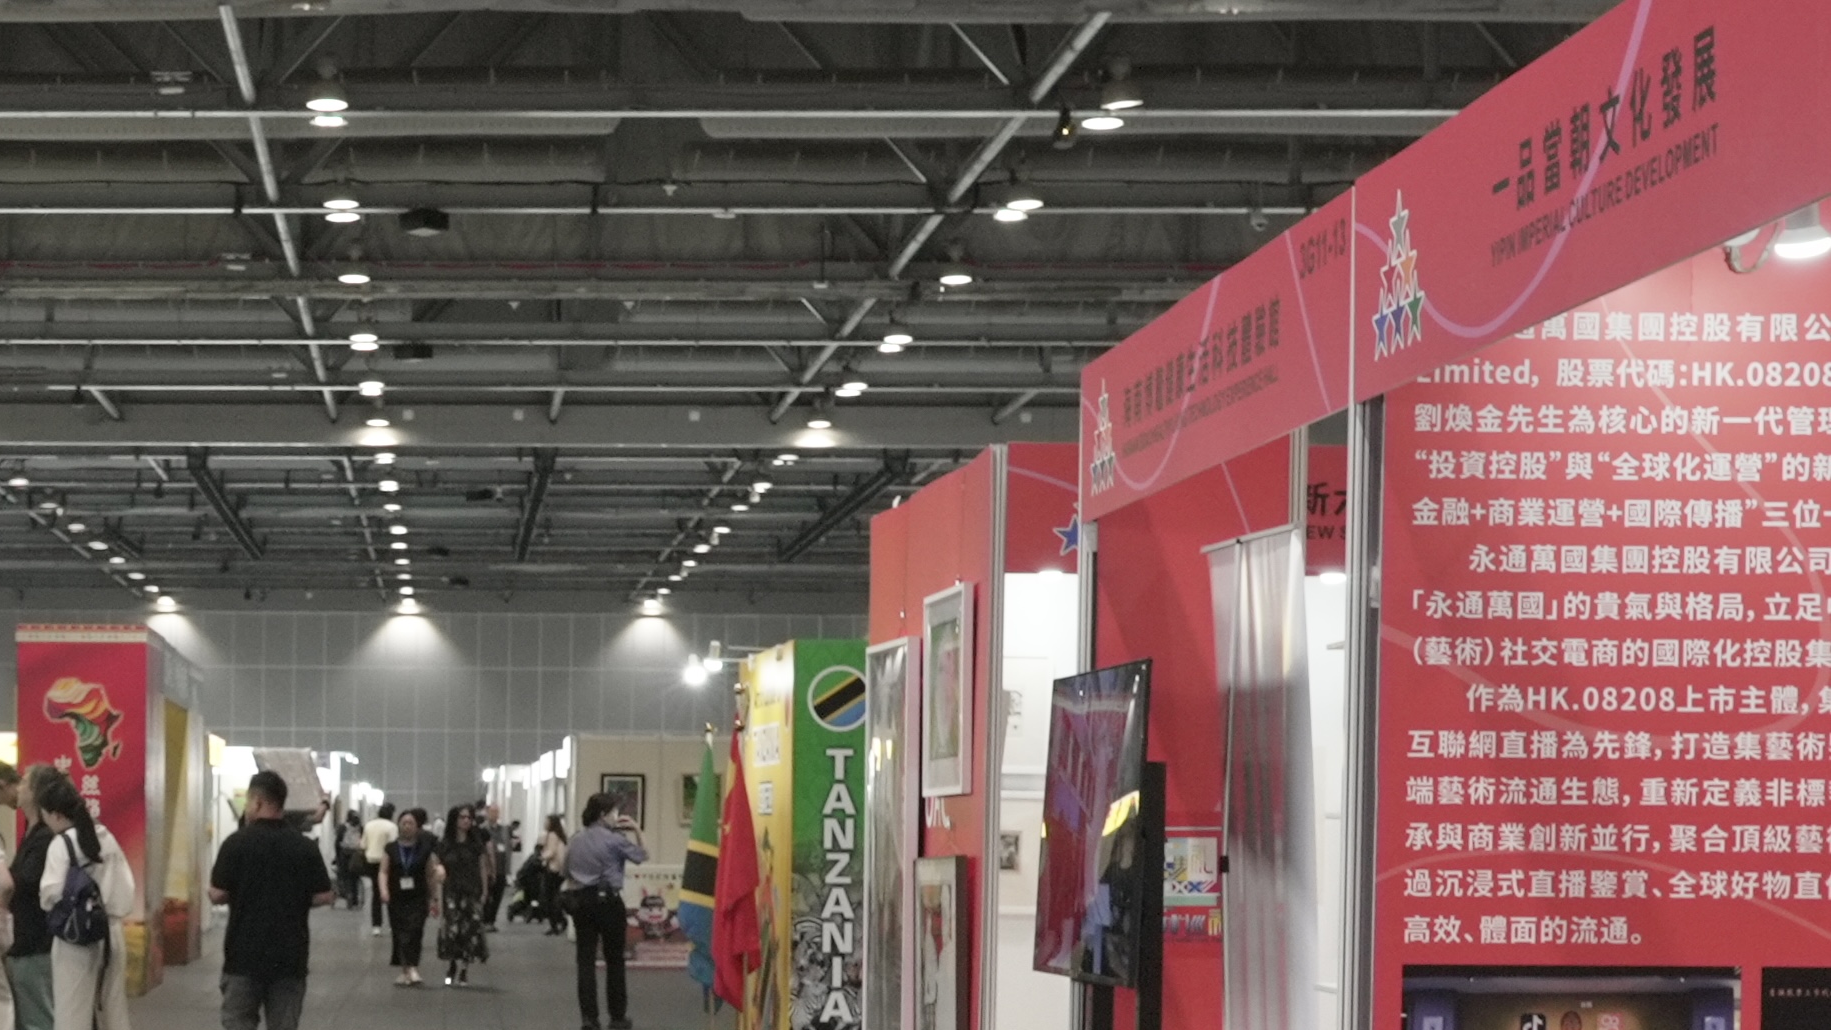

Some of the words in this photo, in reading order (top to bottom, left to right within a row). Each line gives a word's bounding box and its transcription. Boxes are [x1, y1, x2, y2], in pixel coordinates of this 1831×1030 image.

[1491, 24, 1717, 210] 一品當朝文化發展
[1520, 207, 1567, 252] IMPERIAL
[1569, 175, 1623, 227] CULTURE
[1626, 122, 1719, 200] DEVELOPMENT
[1515, 312, 1831, 342] 萬國集團控股有限公
[1411, 497, 1831, 529] 金融+商業運營+國際傳播”三位
[1469, 544, 1831, 576] 永通萬國集團控股有限公司
[1411, 589, 1831, 622] 「永通萬國」的貴氣與格局，立足
[1407, 730, 1831, 761] 互聯網直播為先鋒，打造集藝術
[1406, 776, 1831, 808] 端藝術流通生態，重新定義非標
[1405, 823, 1831, 855] 承與商業創新並行，聚合頂級藝
[819, 748, 858, 1024] TANZANIA
[1404, 869, 1831, 900] 過沉浸式直播鑒賞、全球好物直
